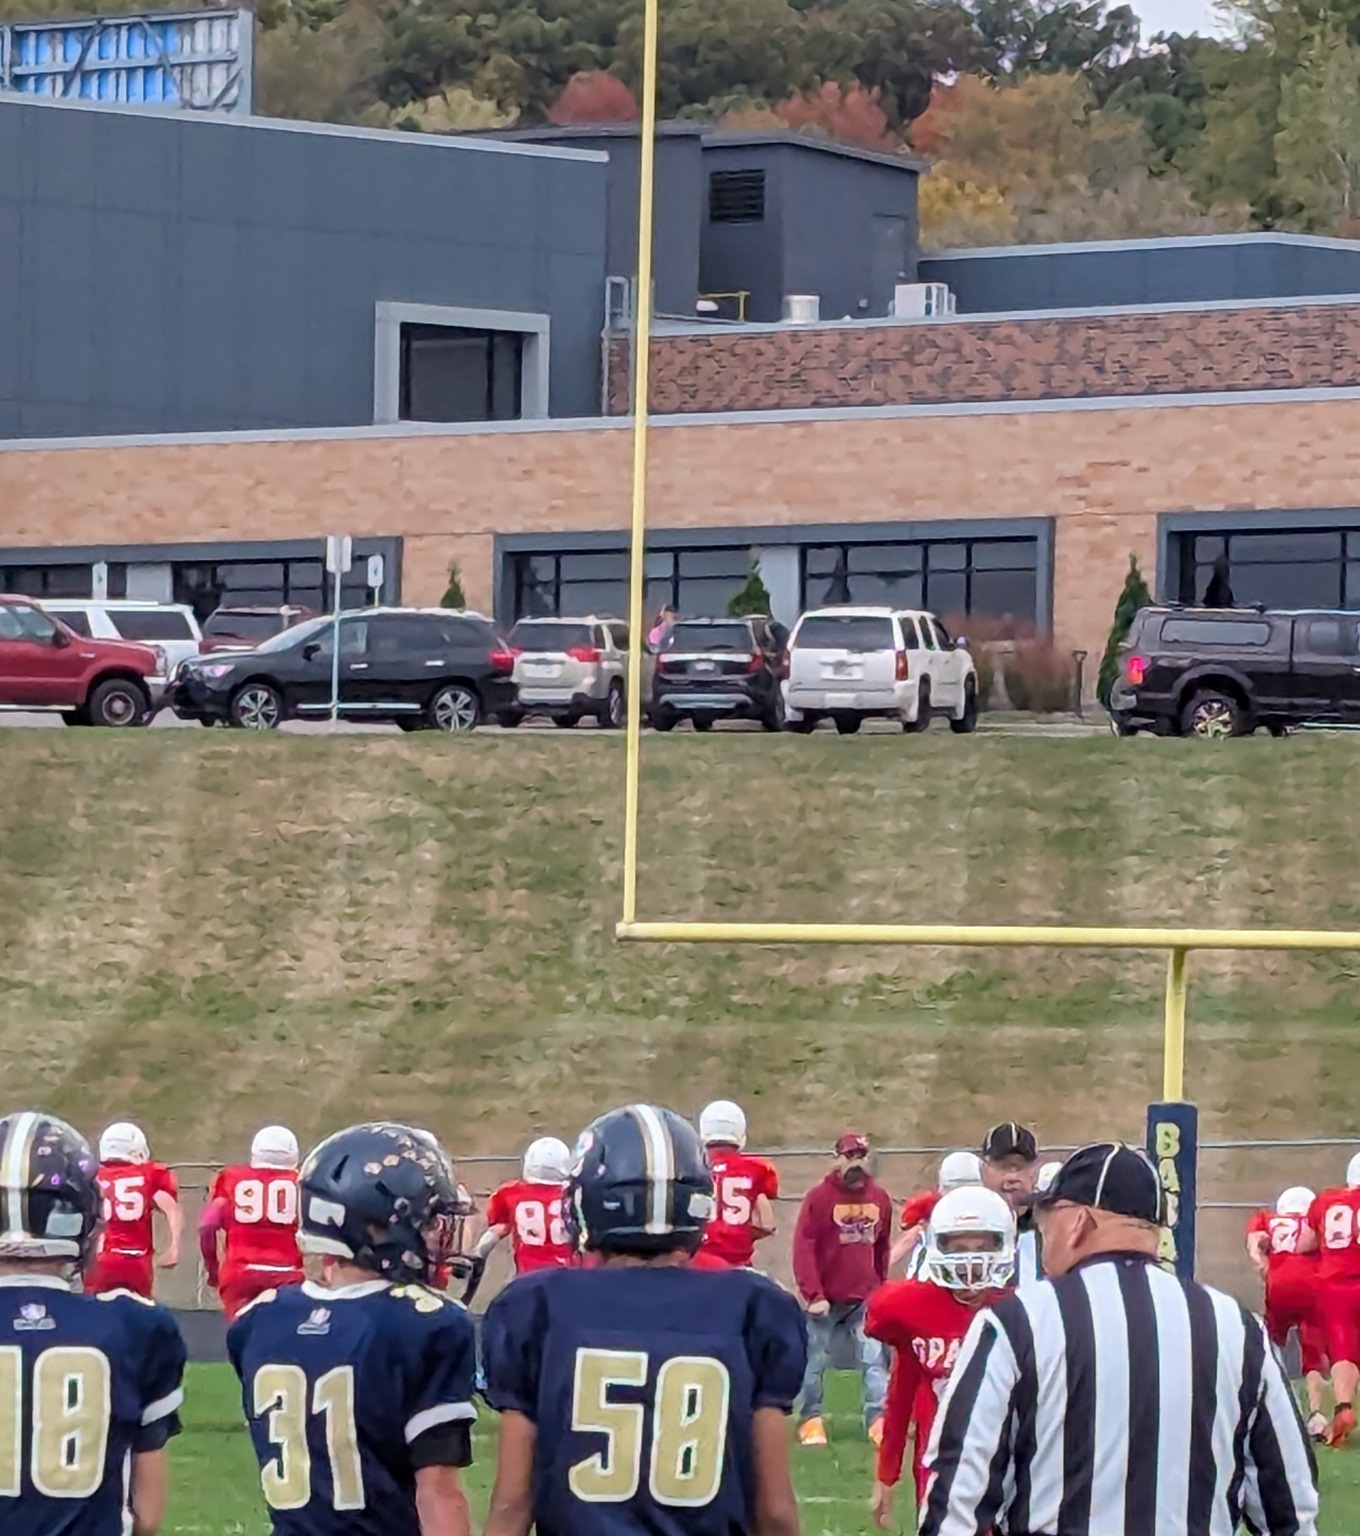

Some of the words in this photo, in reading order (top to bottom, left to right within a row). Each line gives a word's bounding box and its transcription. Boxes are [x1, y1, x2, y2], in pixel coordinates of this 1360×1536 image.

[234, 1179, 297, 1224] 90
[252, 1363, 366, 1510] 31
[568, 1346, 731, 1508] 58
